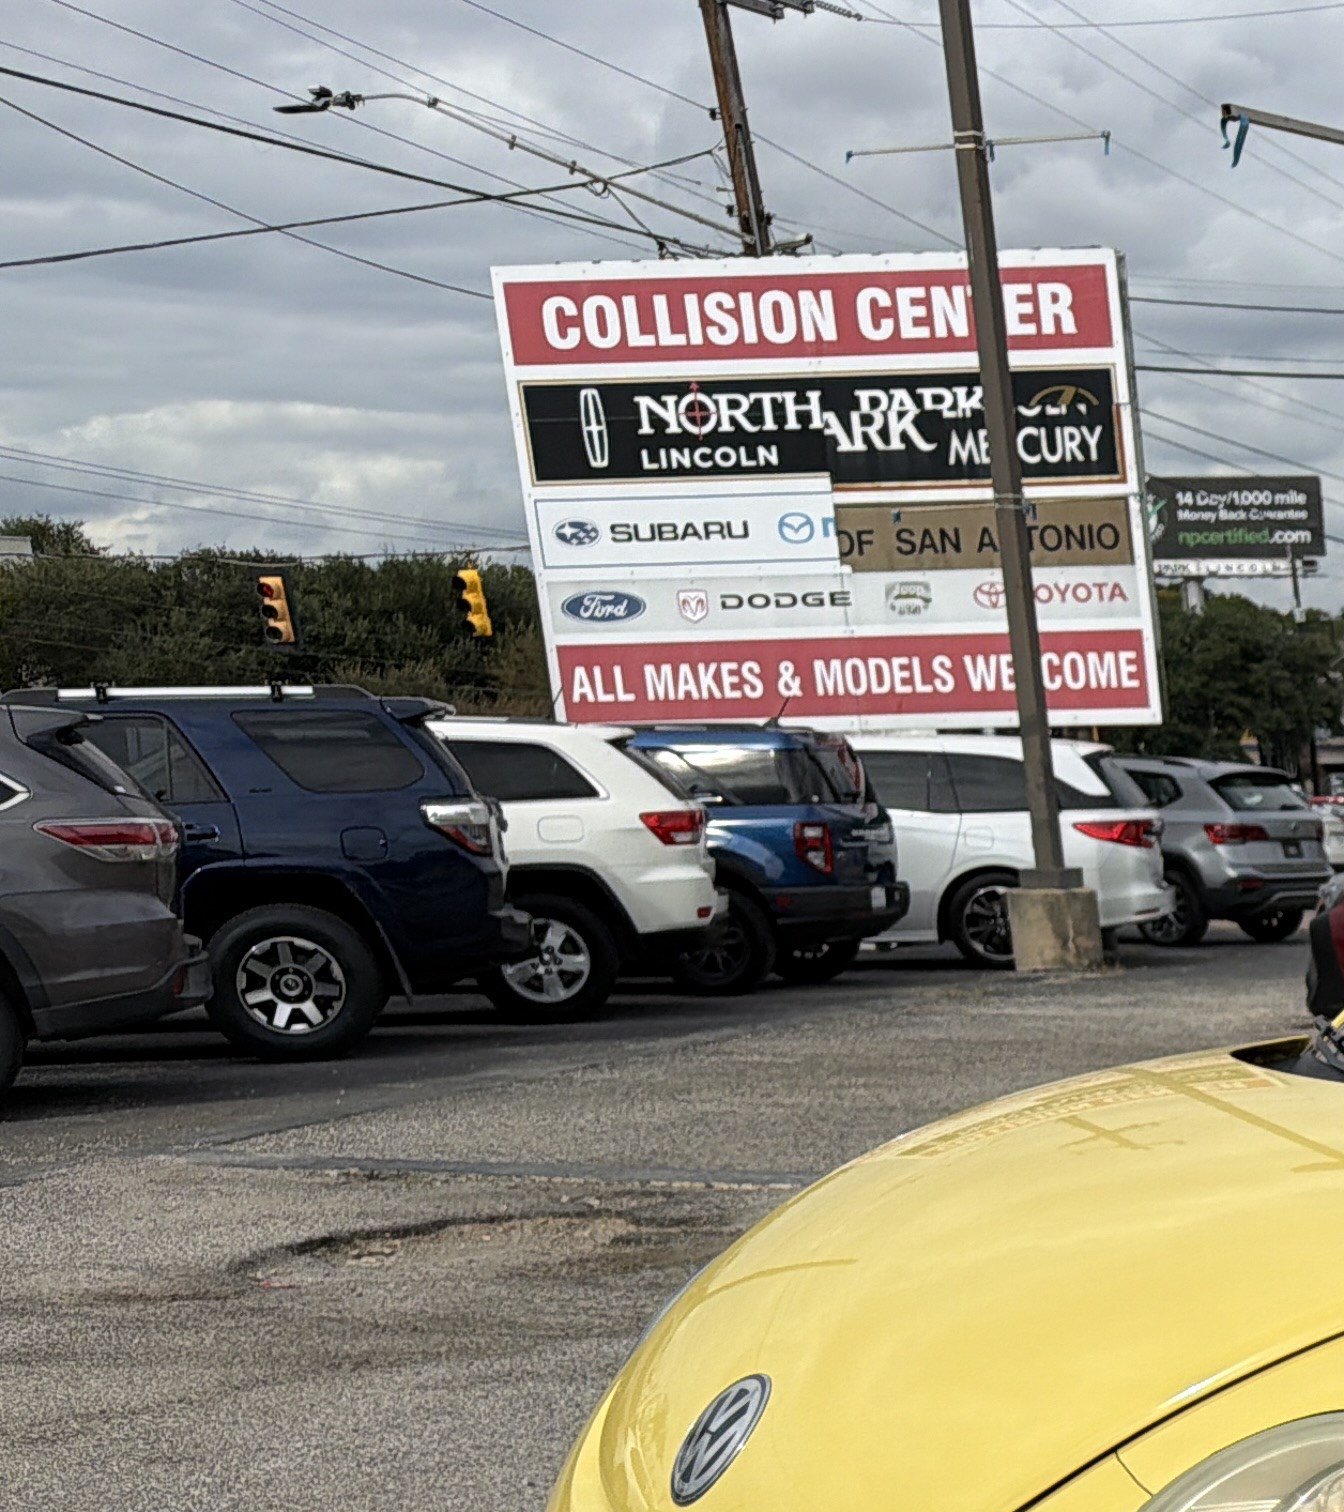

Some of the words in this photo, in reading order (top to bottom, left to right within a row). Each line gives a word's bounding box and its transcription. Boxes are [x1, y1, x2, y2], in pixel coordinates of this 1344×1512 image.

[541, 288, 838, 350] COLLISION
[856, 282, 1079, 341] CENER
[633, 389, 826, 435] NORTH
[640, 444, 779, 471] LINCOLN
[948, 424, 1103, 467] MECURY
[1176, 490, 1194, 506] 14
[1274, 489, 1307, 506] mile
[1177, 508, 1217, 524] Money
[1219, 508, 1247, 521] Back
[609, 520, 750, 543] SUBARU
[895, 526, 962, 556] SAN
[976, 522, 1121, 554] ATONIO
[1178, 527, 1312, 548] npcertified.com
[720, 590, 853, 611] DODGE
[1033, 582, 1129, 604] OYOTA
[579, 594, 628, 619] Ford
[572, 664, 636, 703] ALL
[643, 660, 764, 701] MAKES
[777, 660, 803, 698] &
[813, 654, 956, 696] MODELS
[964, 650, 1141, 693] WECOME
